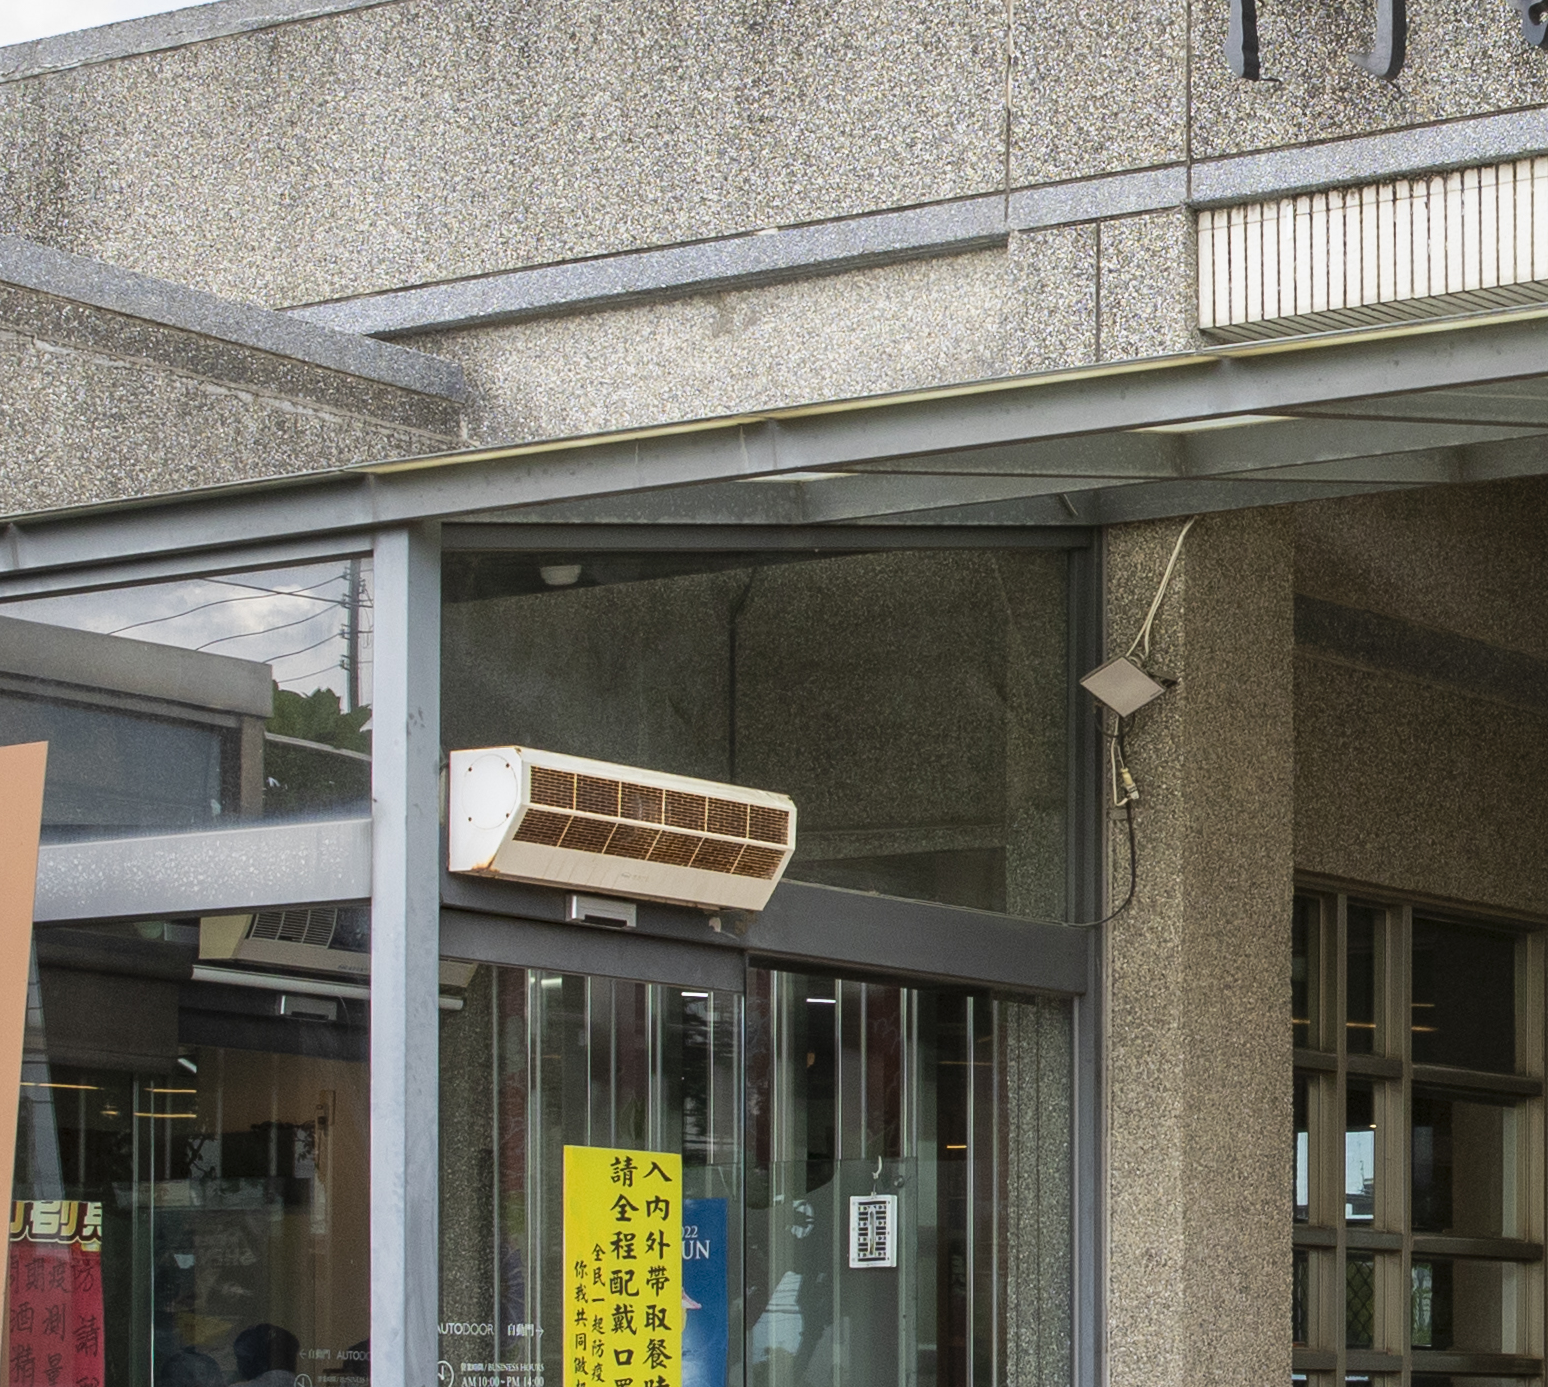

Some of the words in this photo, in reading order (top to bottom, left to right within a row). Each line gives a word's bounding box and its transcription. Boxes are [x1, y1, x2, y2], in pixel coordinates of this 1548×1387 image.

[592, 1243, 606, 1383] 全民一起防疫
